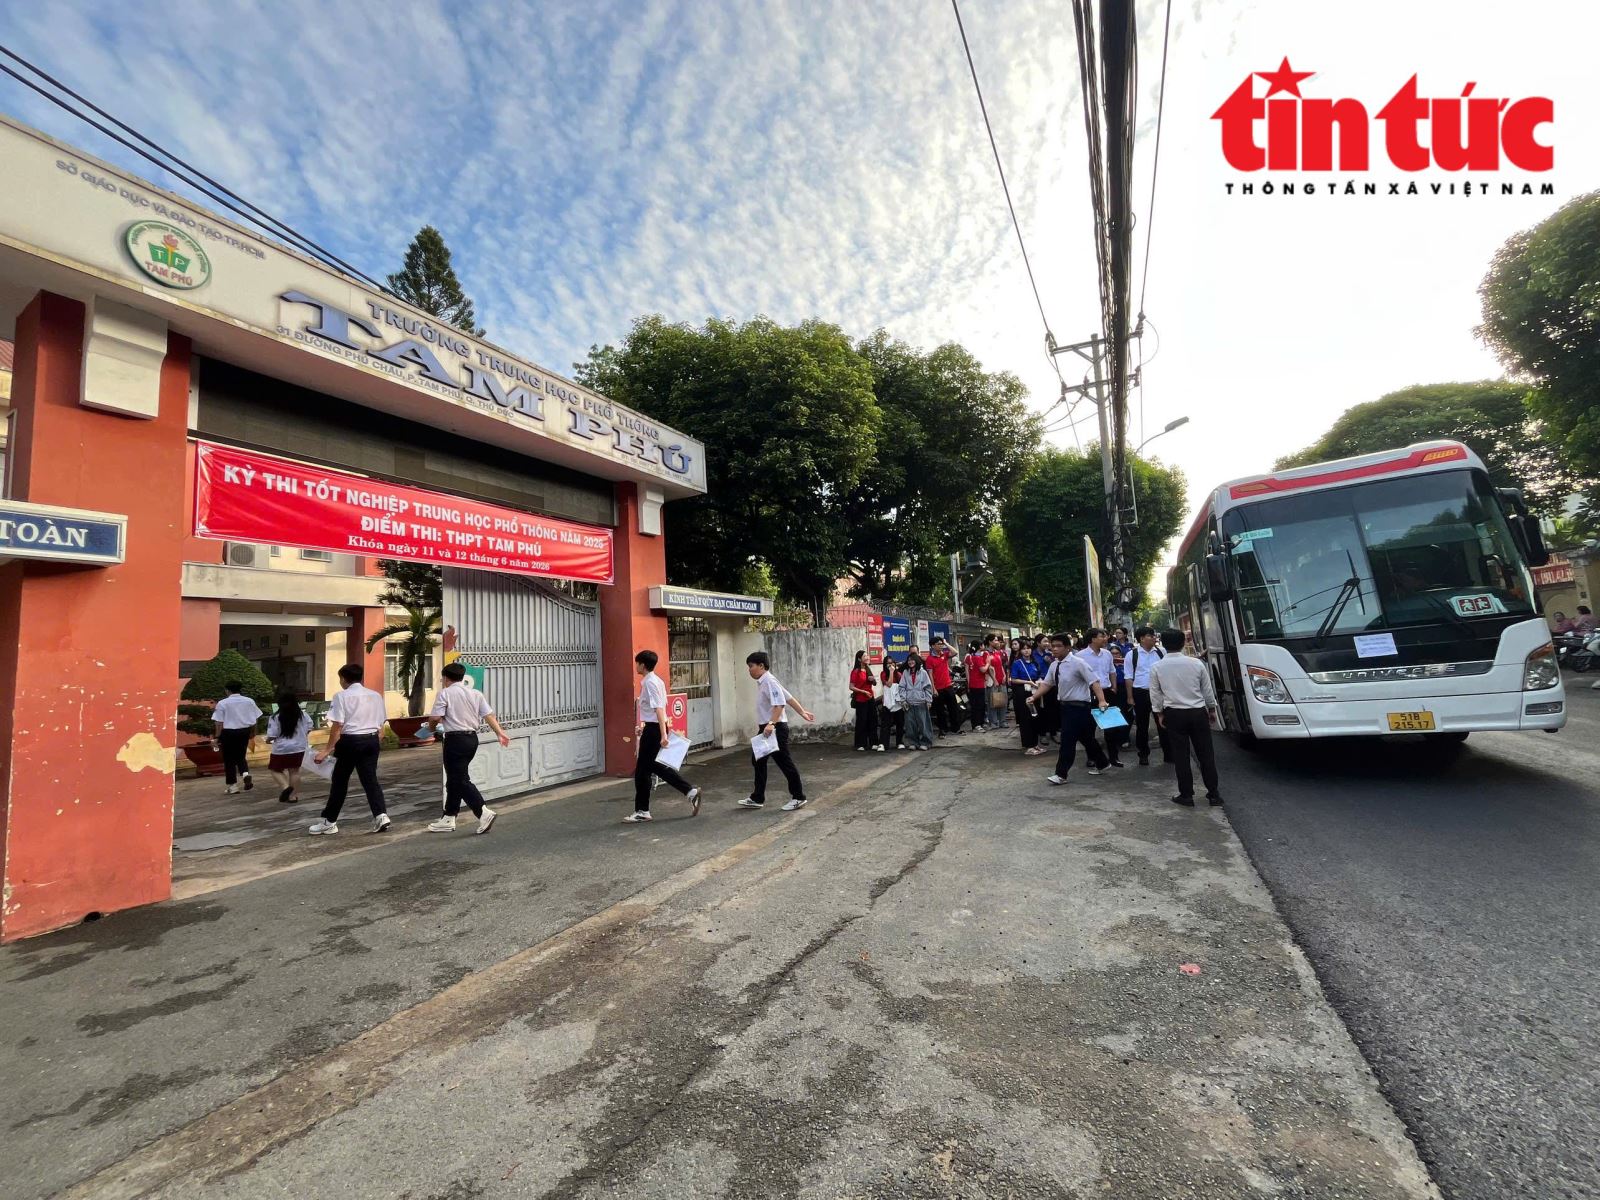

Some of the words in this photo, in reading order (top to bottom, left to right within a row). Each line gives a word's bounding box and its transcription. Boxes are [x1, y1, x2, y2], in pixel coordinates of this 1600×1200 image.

[80, 171, 117, 193] GIÁO
[120, 187, 150, 208] DỤC
[170, 211, 196, 228] ĐÀO
[198, 223, 222, 241] TẠO
[145, 260, 168, 278] TAM
[276, 325, 290, 336] 31
[294, 330, 342, 354] ĐƯỜNG
[418, 377, 439, 391] TAM
[367, 301, 471, 358] TRƯỜNG
[475, 349, 542, 390] TRUNG
[545, 381, 580, 405] HỌC
[583, 398, 615, 420] PHỔ
[617, 412, 660, 440] THÔNG
[276, 289, 546, 421] TAM
[568, 407, 692, 474] PHÚ
[224, 464, 256, 486] KỲ
[262, 472, 298, 494] THI
[303, 478, 341, 502] TỐT
[346, 488, 409, 516] NGHIỆP
[413, 501, 461, 524] TRUNG
[464, 512, 491, 531] HỌC
[494, 515, 518, 534] PHỔ
[522, 523, 558, 541] THÔNG
[560, 530, 581, 545] NĂM
[583, 535, 605, 549] 2026
[0, 519, 88, 548] TOÀN
[347, 535, 384, 550] Khóa
[388, 541, 419, 557] ngày
[422, 545, 435, 557] 11
[438, 547, 451, 558] và
[455, 550, 467, 560] 12
[469, 552, 499, 566] tháng
[501, 556, 507, 565] 6
[509, 557, 529, 568] năm
[531, 560, 551, 571] 2026
[361, 513, 406, 537] ĐIỂM
[410, 523, 442, 542] THI:
[445, 529, 483, 548] THPT
[486, 536, 514, 553] TAM
[517, 541, 542, 557] PHÚ
[741, 601, 757, 611] NGOAN
[1394, 720, 1430, 730] 215.17
[1400, 713, 1420, 721] 51B
